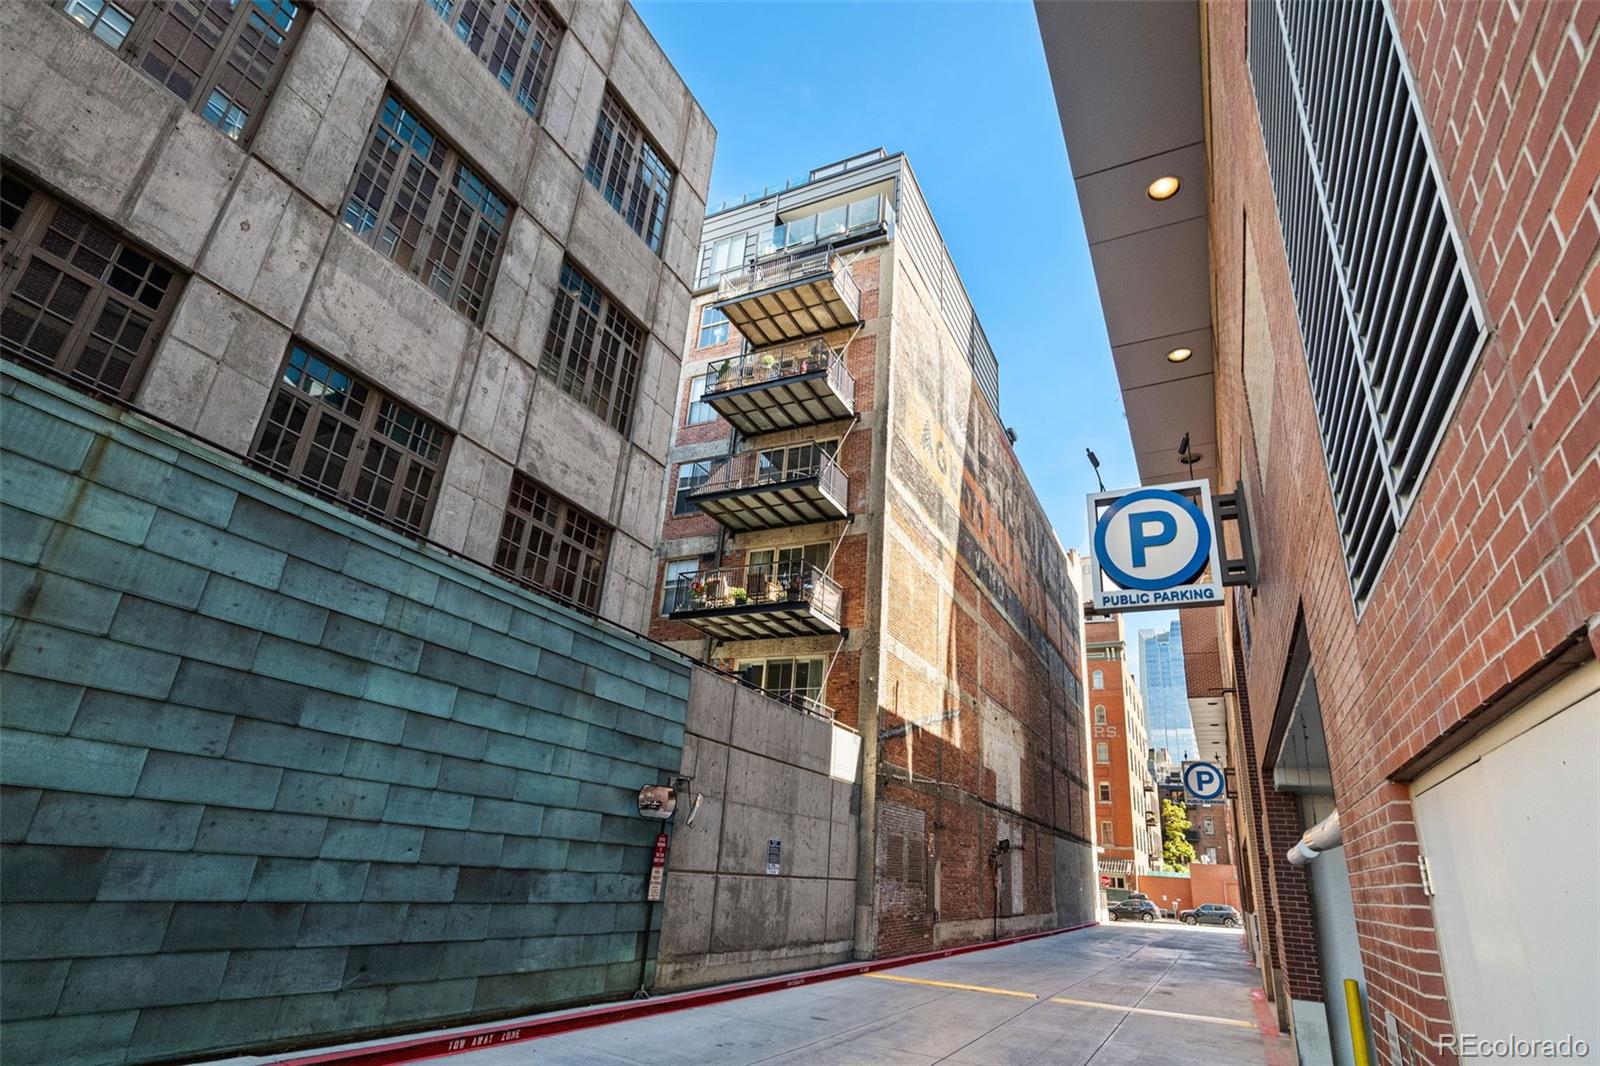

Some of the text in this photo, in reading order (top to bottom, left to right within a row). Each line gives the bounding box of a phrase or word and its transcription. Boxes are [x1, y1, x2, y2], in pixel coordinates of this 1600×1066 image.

[1128, 510, 1178, 568] P
[1102, 588, 1215, 607] PUBLIC PARKING
[1196, 770, 1215, 791] P
[448, 1029, 521, 1051] TOW AWAY ZONE
